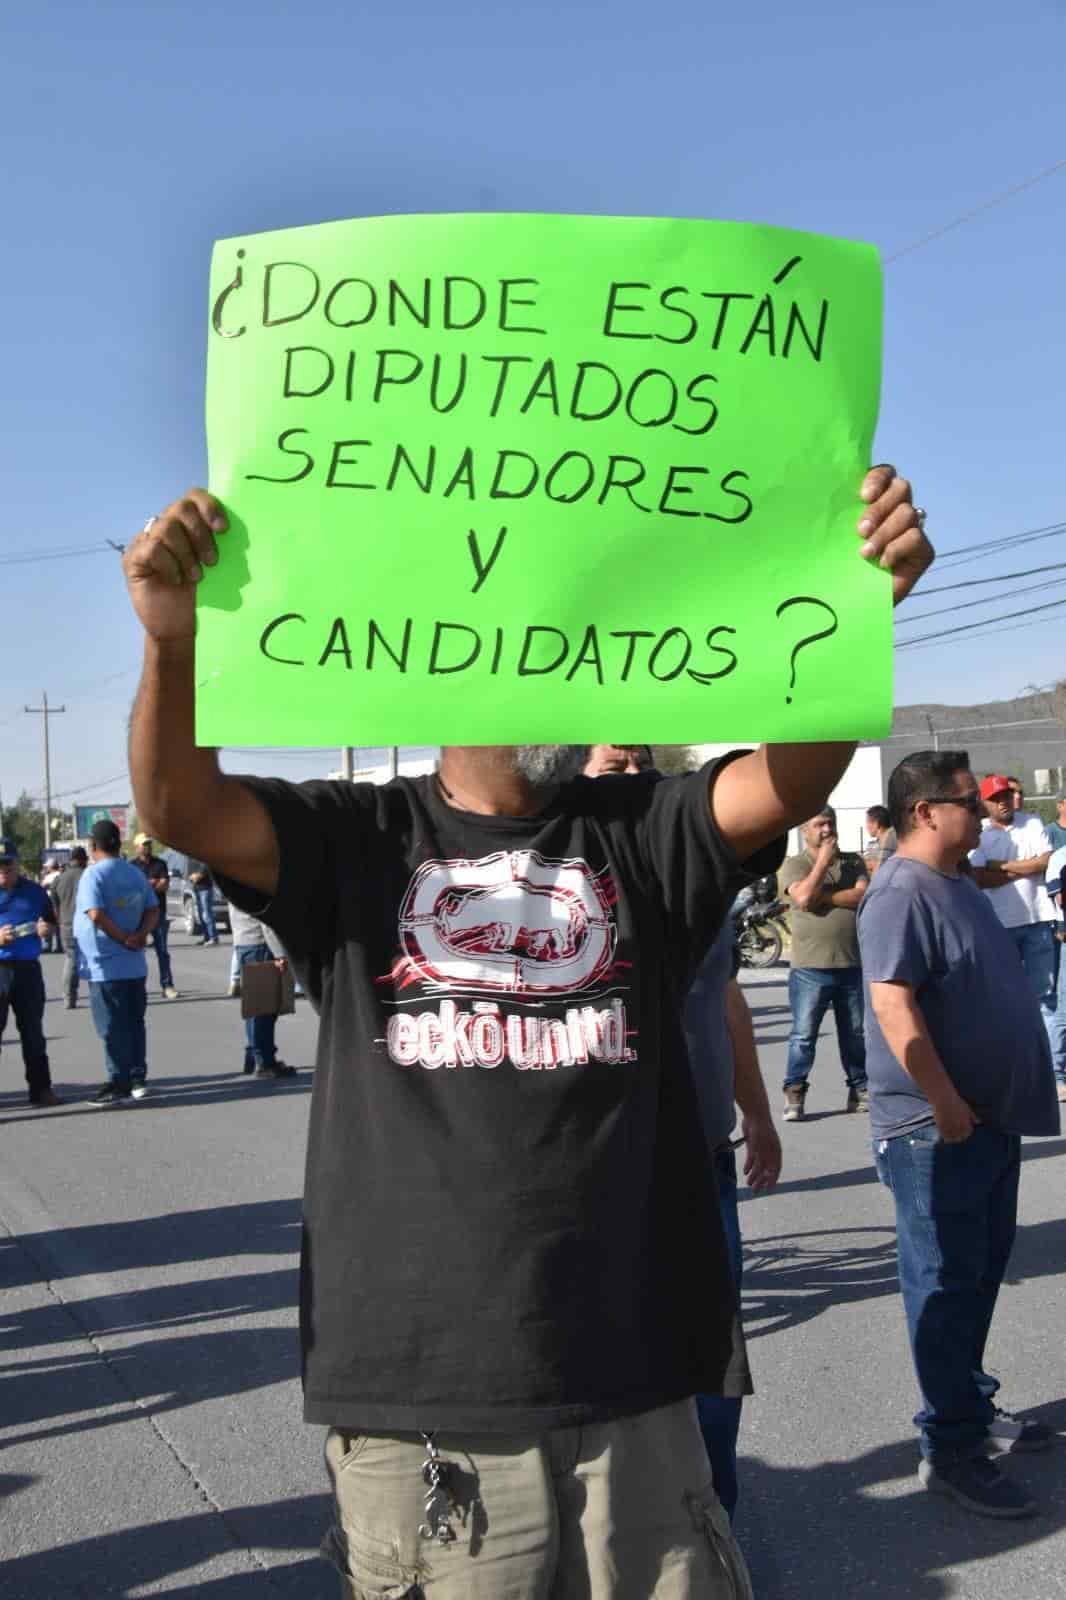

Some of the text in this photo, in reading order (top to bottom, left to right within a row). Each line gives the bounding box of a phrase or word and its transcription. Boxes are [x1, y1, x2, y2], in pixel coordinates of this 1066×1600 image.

[212, 248, 829, 362] ¿DONDE ESTÁN
[283, 345, 719, 436] DIPUTADOS
[245, 428, 753, 524] SENADORES
[259, 612, 738, 686] CANDIDATOS
